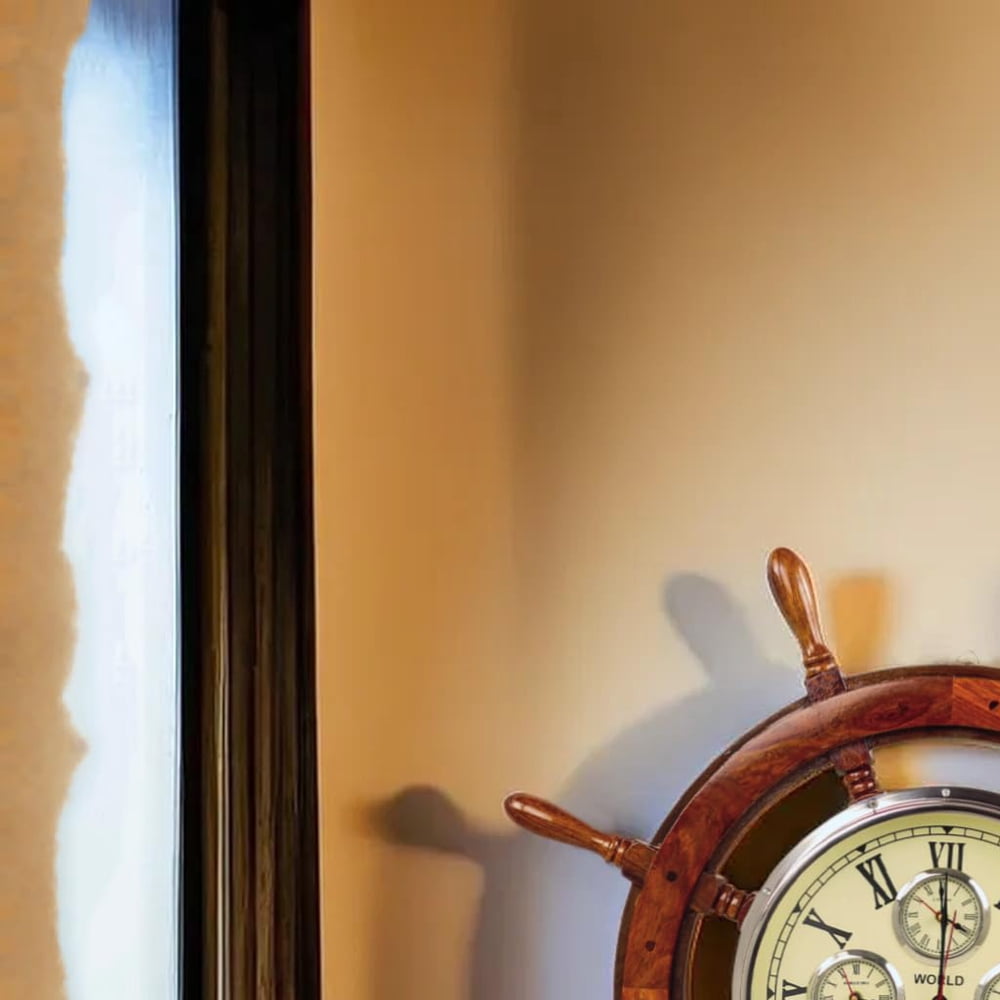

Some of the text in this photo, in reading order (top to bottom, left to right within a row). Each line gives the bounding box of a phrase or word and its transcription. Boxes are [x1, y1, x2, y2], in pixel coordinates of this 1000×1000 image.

[855, 853, 898, 910] XI
[802, 907, 853, 950] X
[914, 973, 965, 986] WOLD
